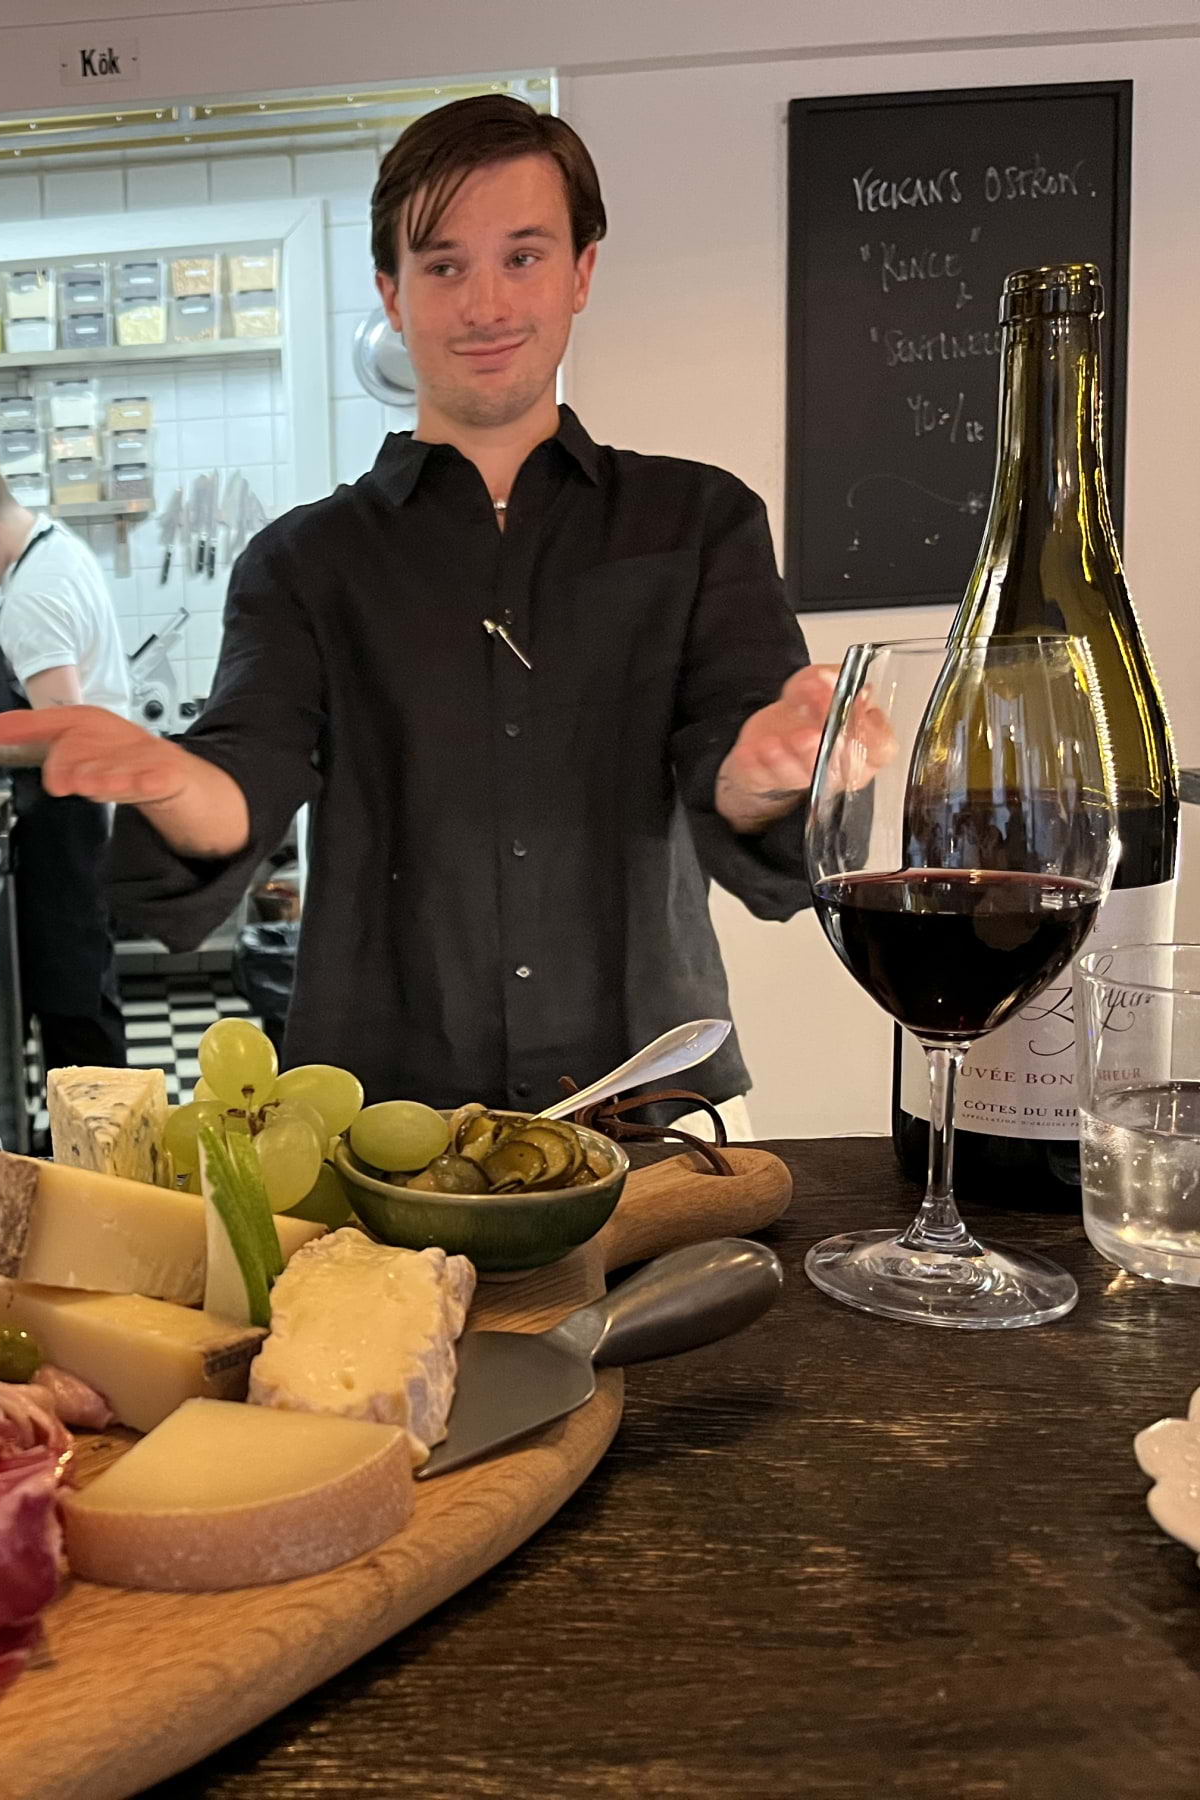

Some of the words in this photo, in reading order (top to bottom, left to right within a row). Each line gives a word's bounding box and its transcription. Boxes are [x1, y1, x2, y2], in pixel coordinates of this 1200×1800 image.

[79, 47, 121, 77] Kök
[960, 1065, 1016, 1083] UVÉE
[963, 1099, 1017, 1115] CÔTES
[1023, 1107, 1048, 1117] DU
